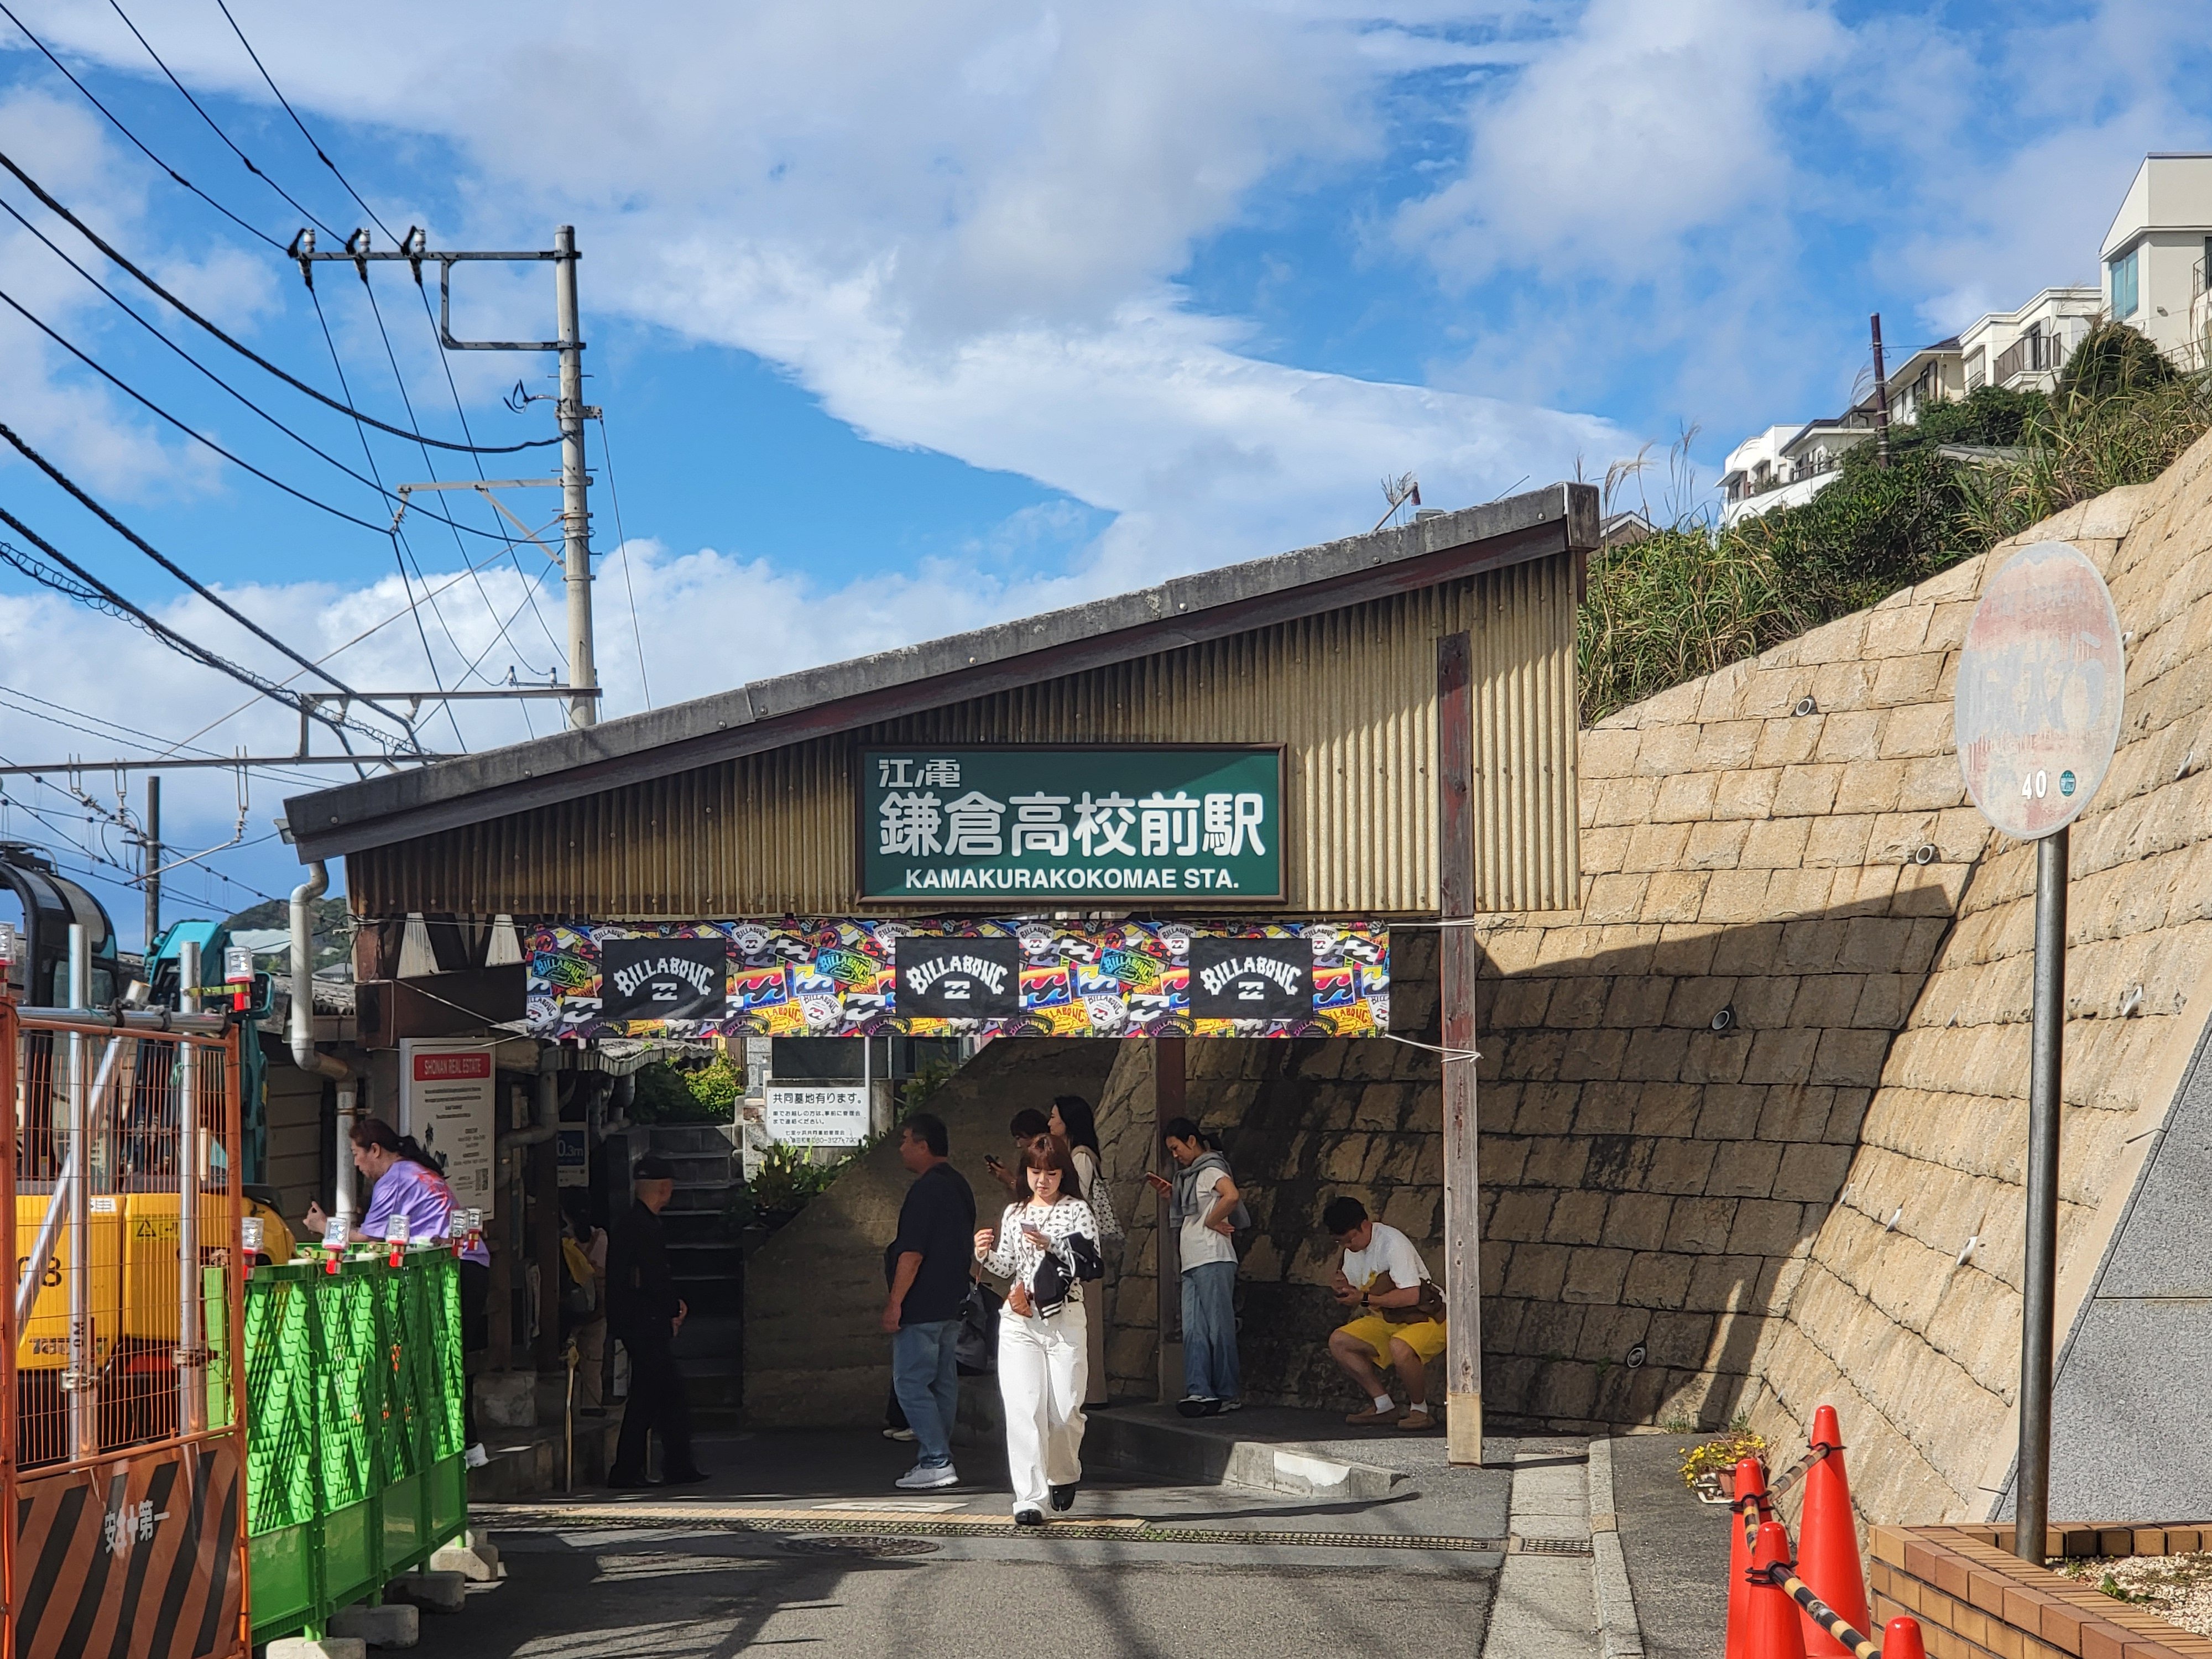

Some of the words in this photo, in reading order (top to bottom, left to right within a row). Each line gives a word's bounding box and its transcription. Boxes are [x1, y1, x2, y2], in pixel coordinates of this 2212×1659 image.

[878, 758, 961, 789] 江ノ電
[2020, 769, 2048, 800] 40
[879, 791, 1266, 857] 鎌倉高校前駅
[906, 868, 1176, 889] KAMAKURAKOKOMAE
[1183, 868, 1239, 889] STA.
[613, 957, 715, 997] BILLABONG
[906, 954, 1009, 995] BILLABONG
[1199, 956, 1302, 996] BILLABONG
[773, 1093, 862, 1104] 共同墓地有ります。
